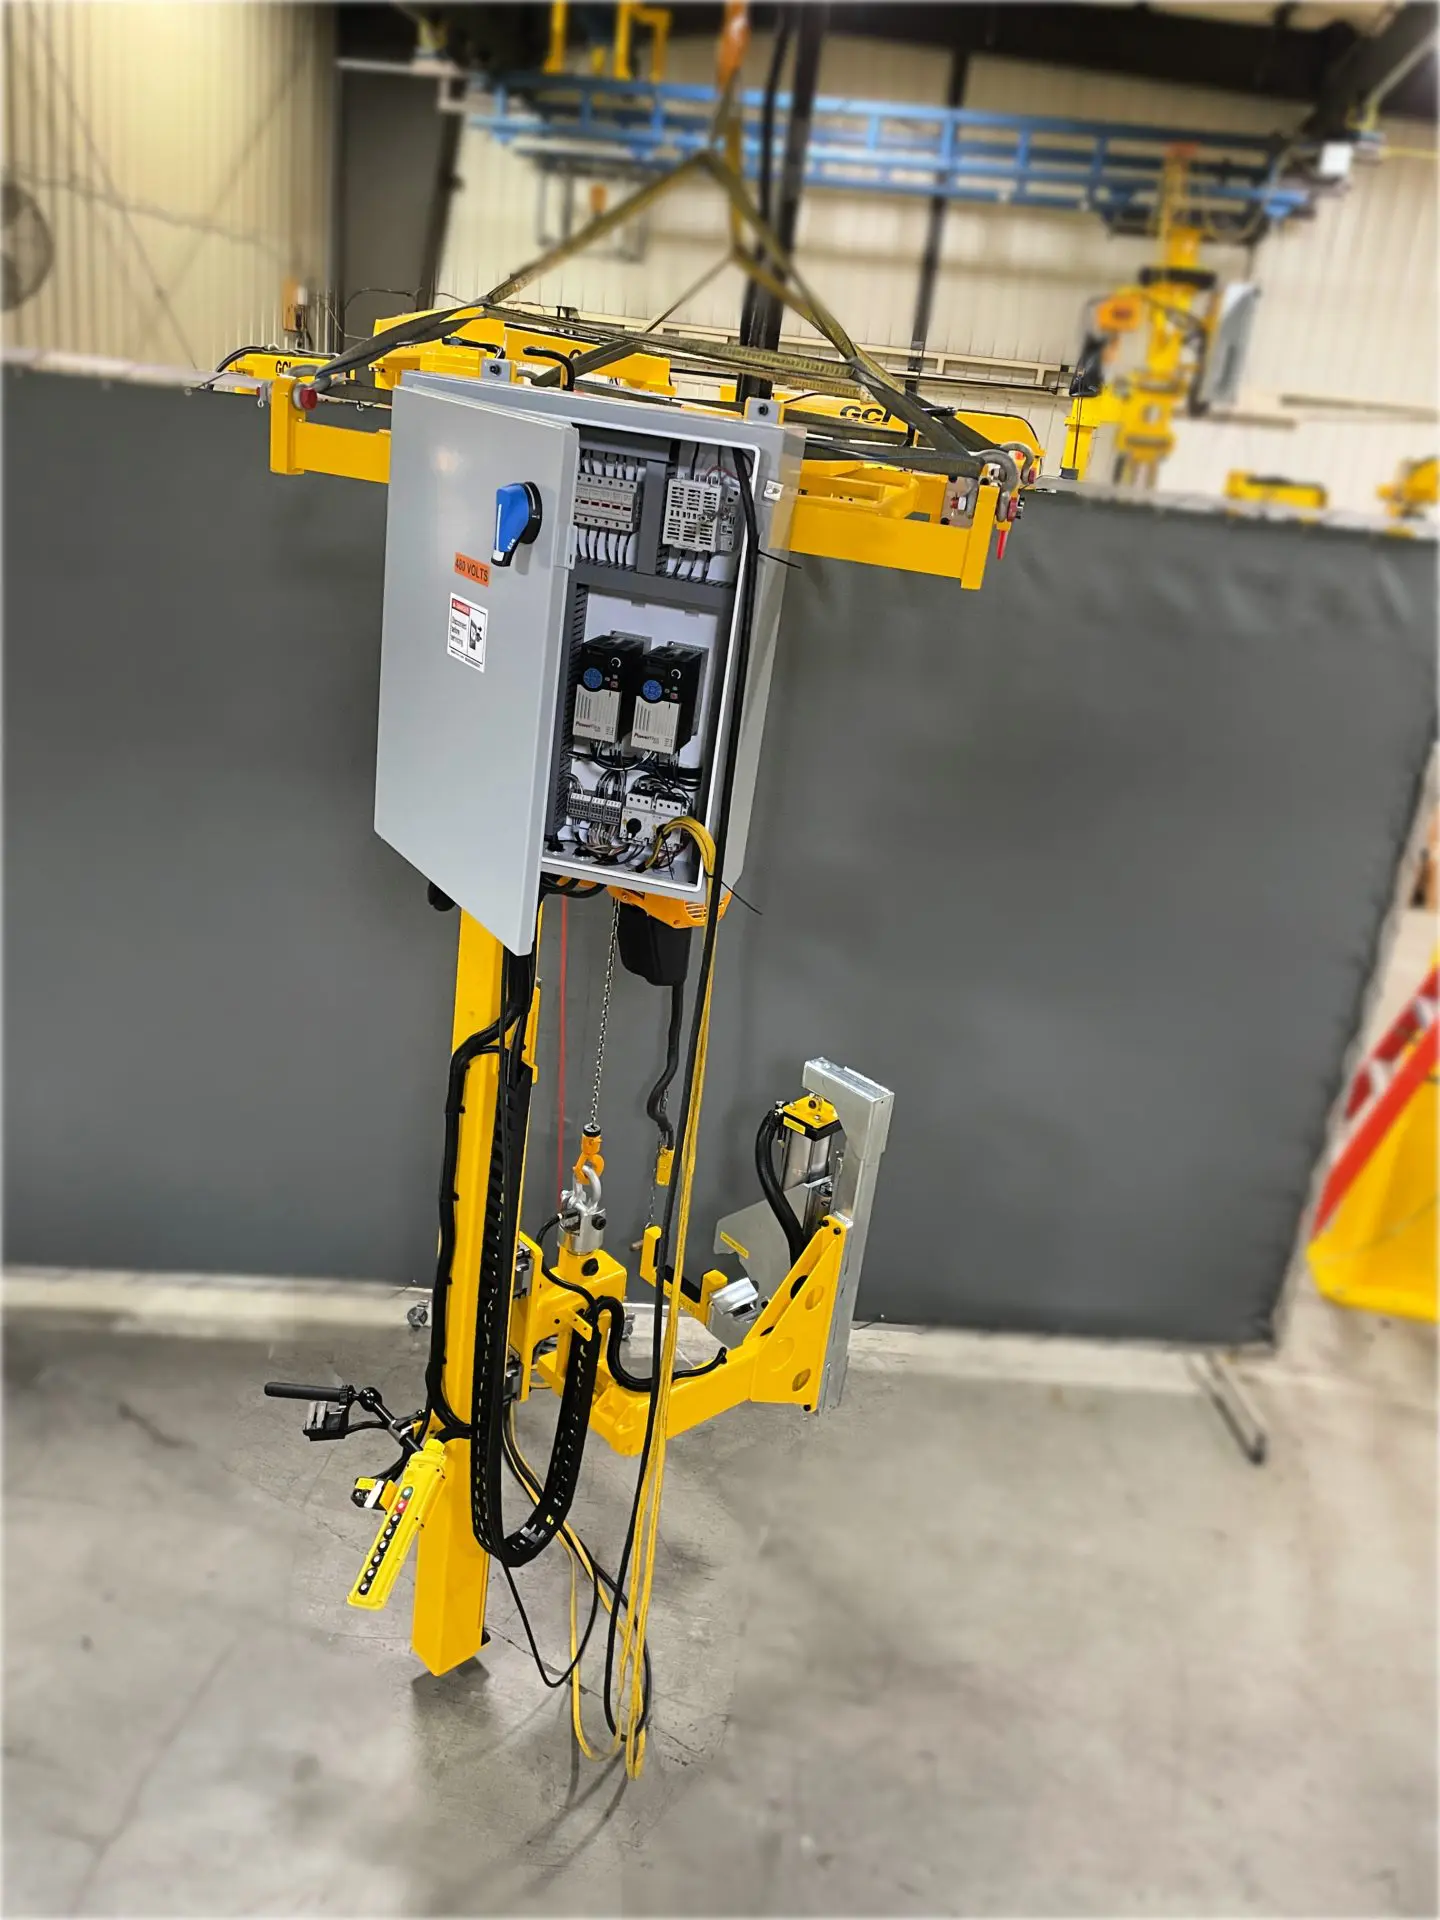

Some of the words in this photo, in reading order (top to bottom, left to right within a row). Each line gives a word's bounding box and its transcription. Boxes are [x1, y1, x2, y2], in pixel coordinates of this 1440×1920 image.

[840, 405, 892, 425] GCI
[455, 558, 466, 572] 480
[467, 564, 489, 582] VOLTS
